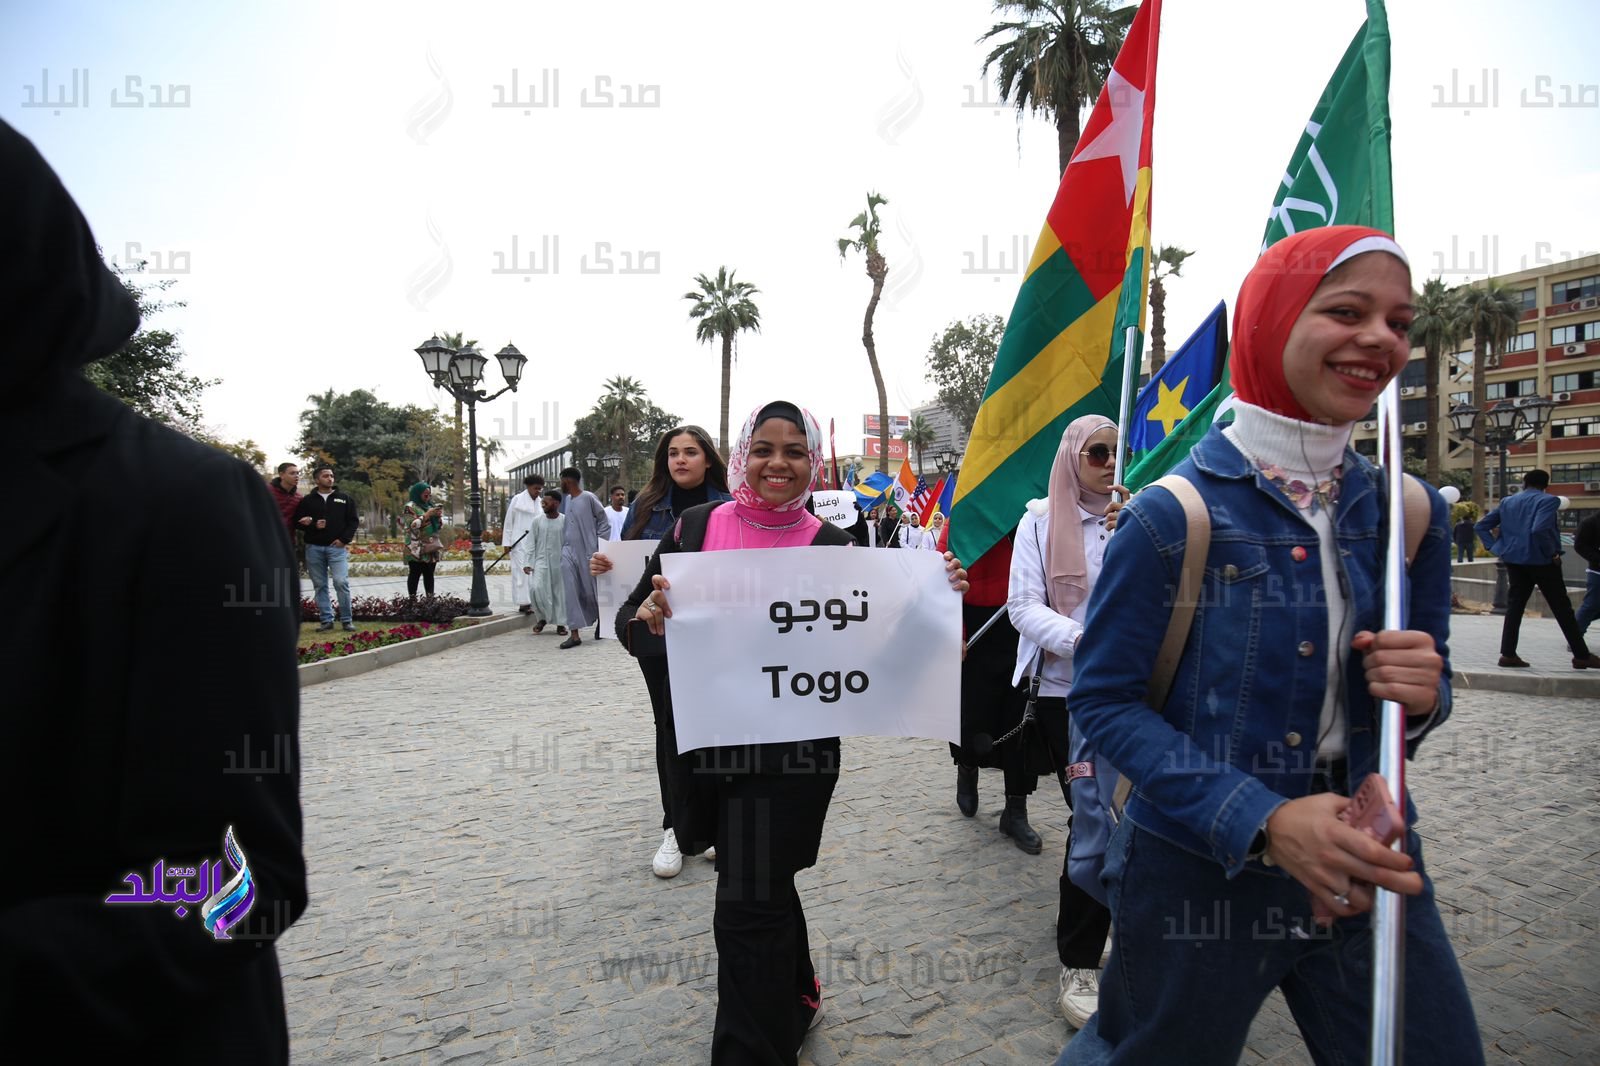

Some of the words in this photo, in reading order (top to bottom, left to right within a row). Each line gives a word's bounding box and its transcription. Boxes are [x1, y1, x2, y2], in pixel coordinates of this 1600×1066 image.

[814, 497, 840, 508] اوغندا
[824, 513, 846, 522] anda
[769, 589, 868, 634] توجو
[762, 665, 869, 703] Togo
